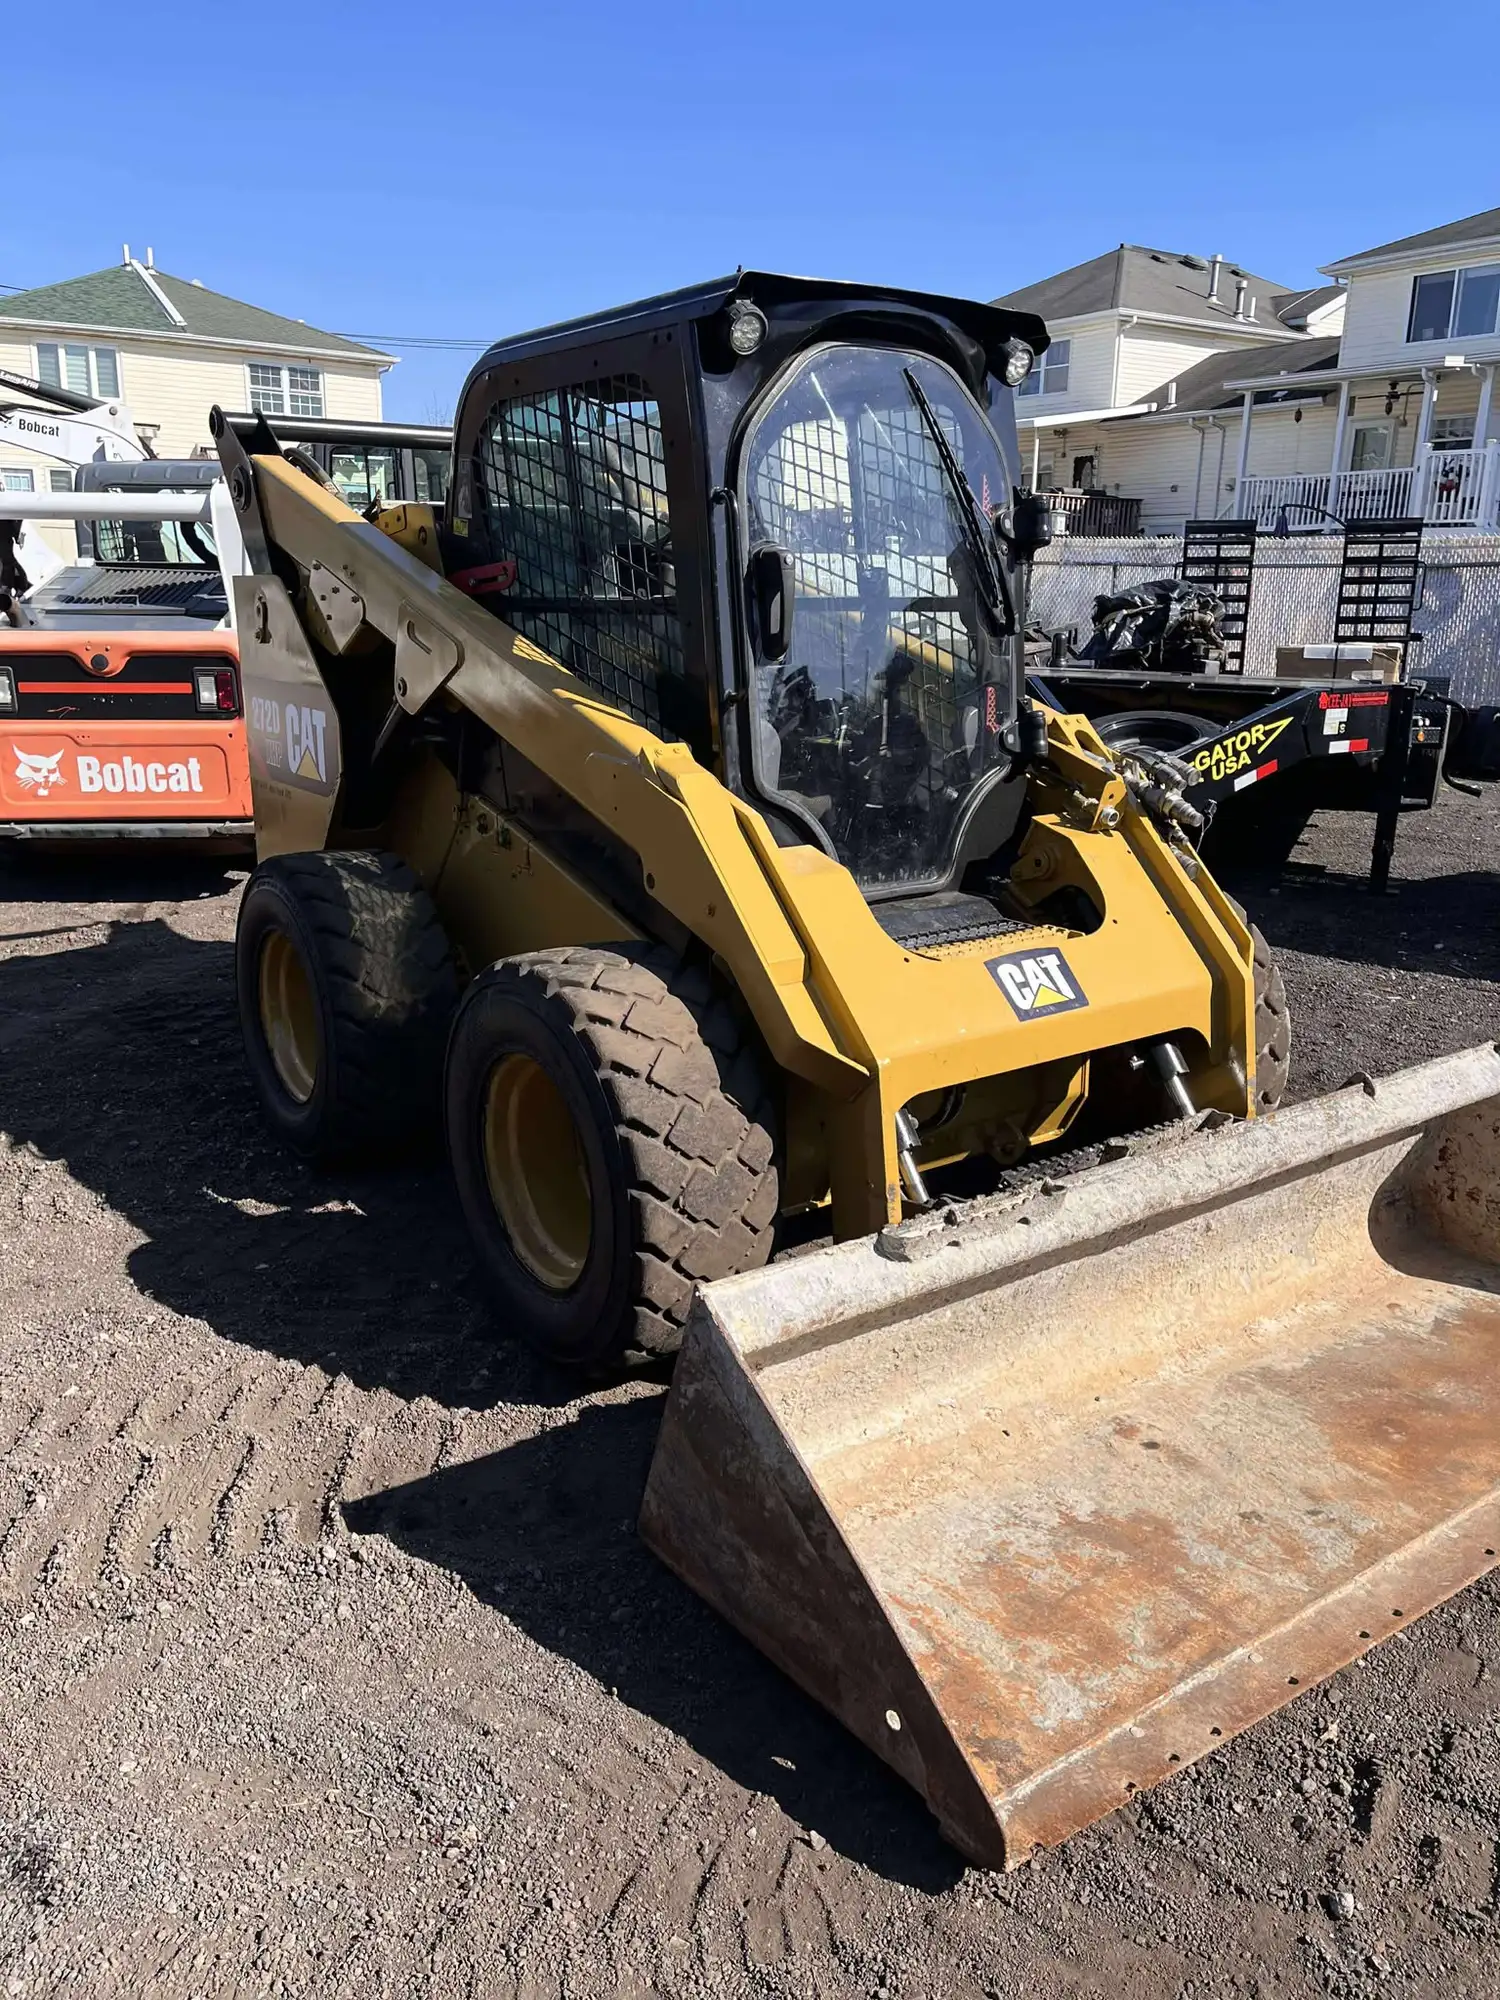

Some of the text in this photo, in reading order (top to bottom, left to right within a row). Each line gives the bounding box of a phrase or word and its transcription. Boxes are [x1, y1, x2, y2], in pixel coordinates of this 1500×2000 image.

[19, 418, 59, 437] Bobcat
[252, 697, 280, 734] 272D
[285, 704, 326, 783] CAT
[1195, 724, 1266, 771] GATOR
[77, 756, 203, 792] Bobcat
[1211, 751, 1252, 780] USA
[997, 954, 1076, 1010] CAT
